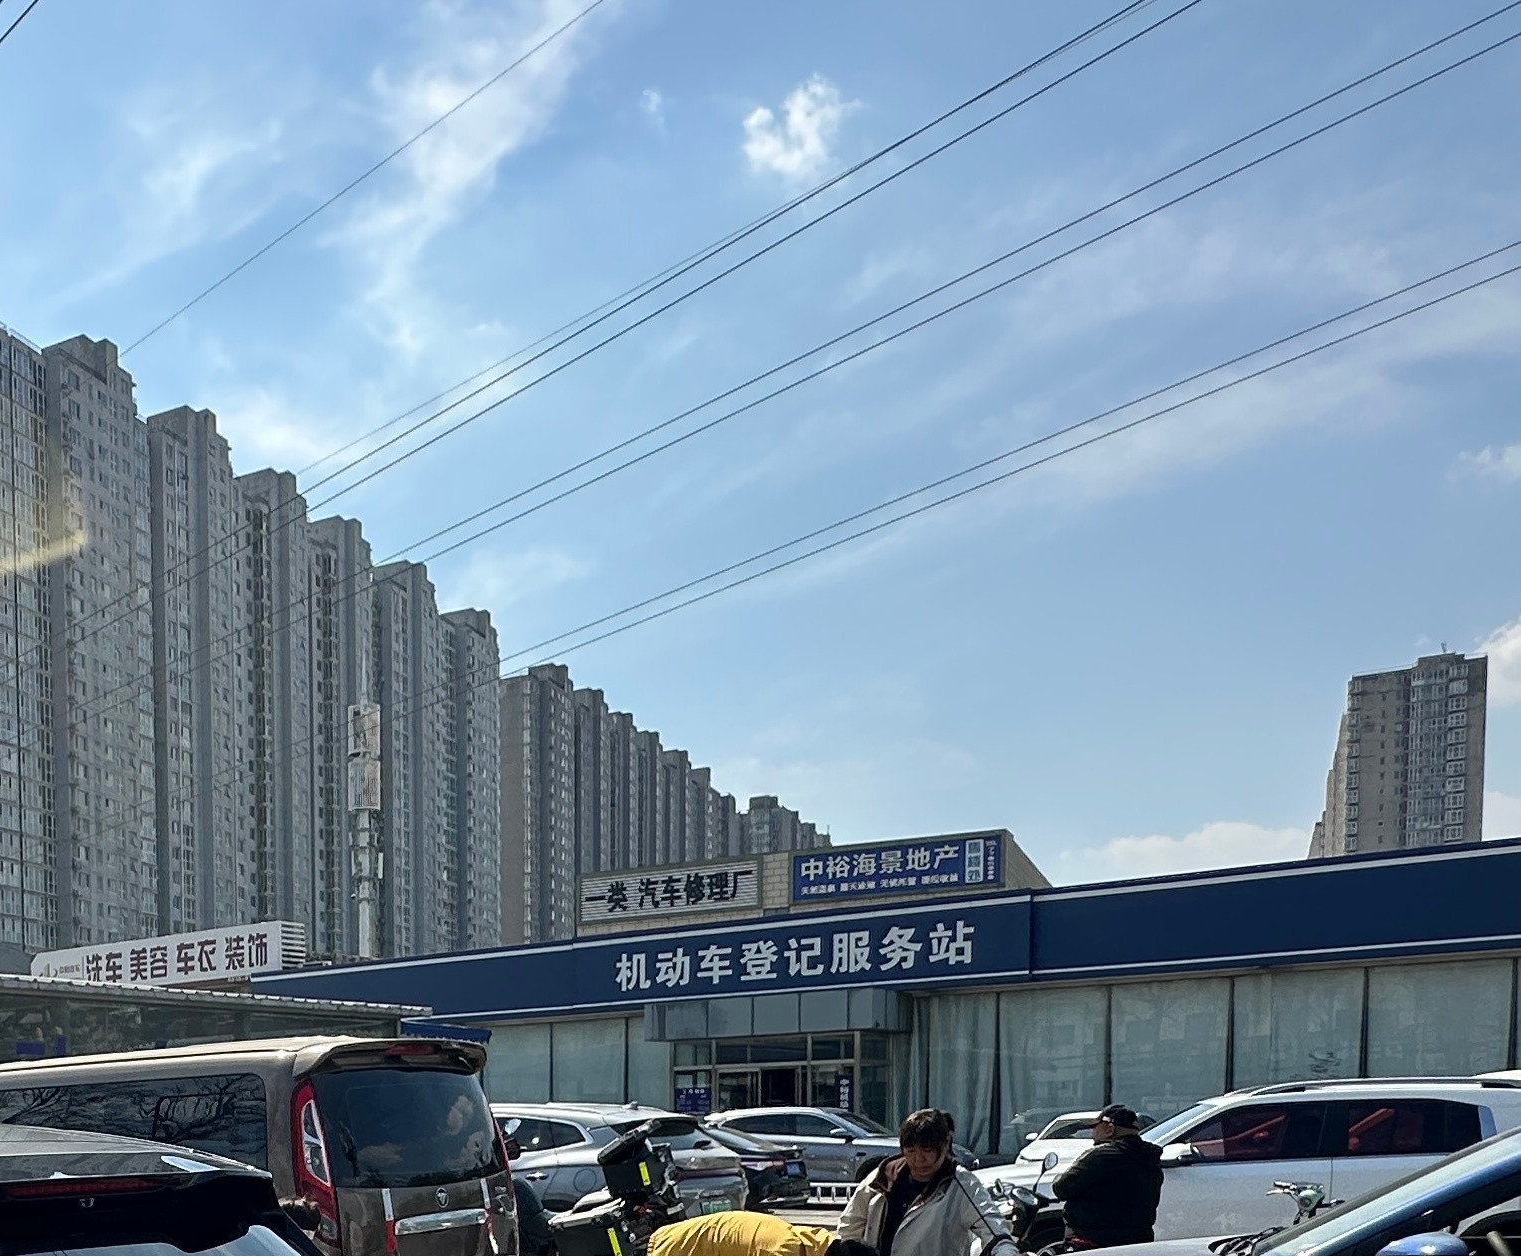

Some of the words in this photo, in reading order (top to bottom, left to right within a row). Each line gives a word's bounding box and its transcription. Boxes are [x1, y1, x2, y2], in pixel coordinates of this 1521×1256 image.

[800, 844, 959, 881] 中裕海景地产
[585, 880, 628, 912] 一类
[638, 870, 753, 908] 汽车修理厂
[86, 951, 123, 982] 洗车
[130, 945, 168, 981] 美容
[177, 939, 217, 975] 车衣
[225, 933, 268, 970] 装饰
[615, 920, 975, 992] 机动车登记服务站
